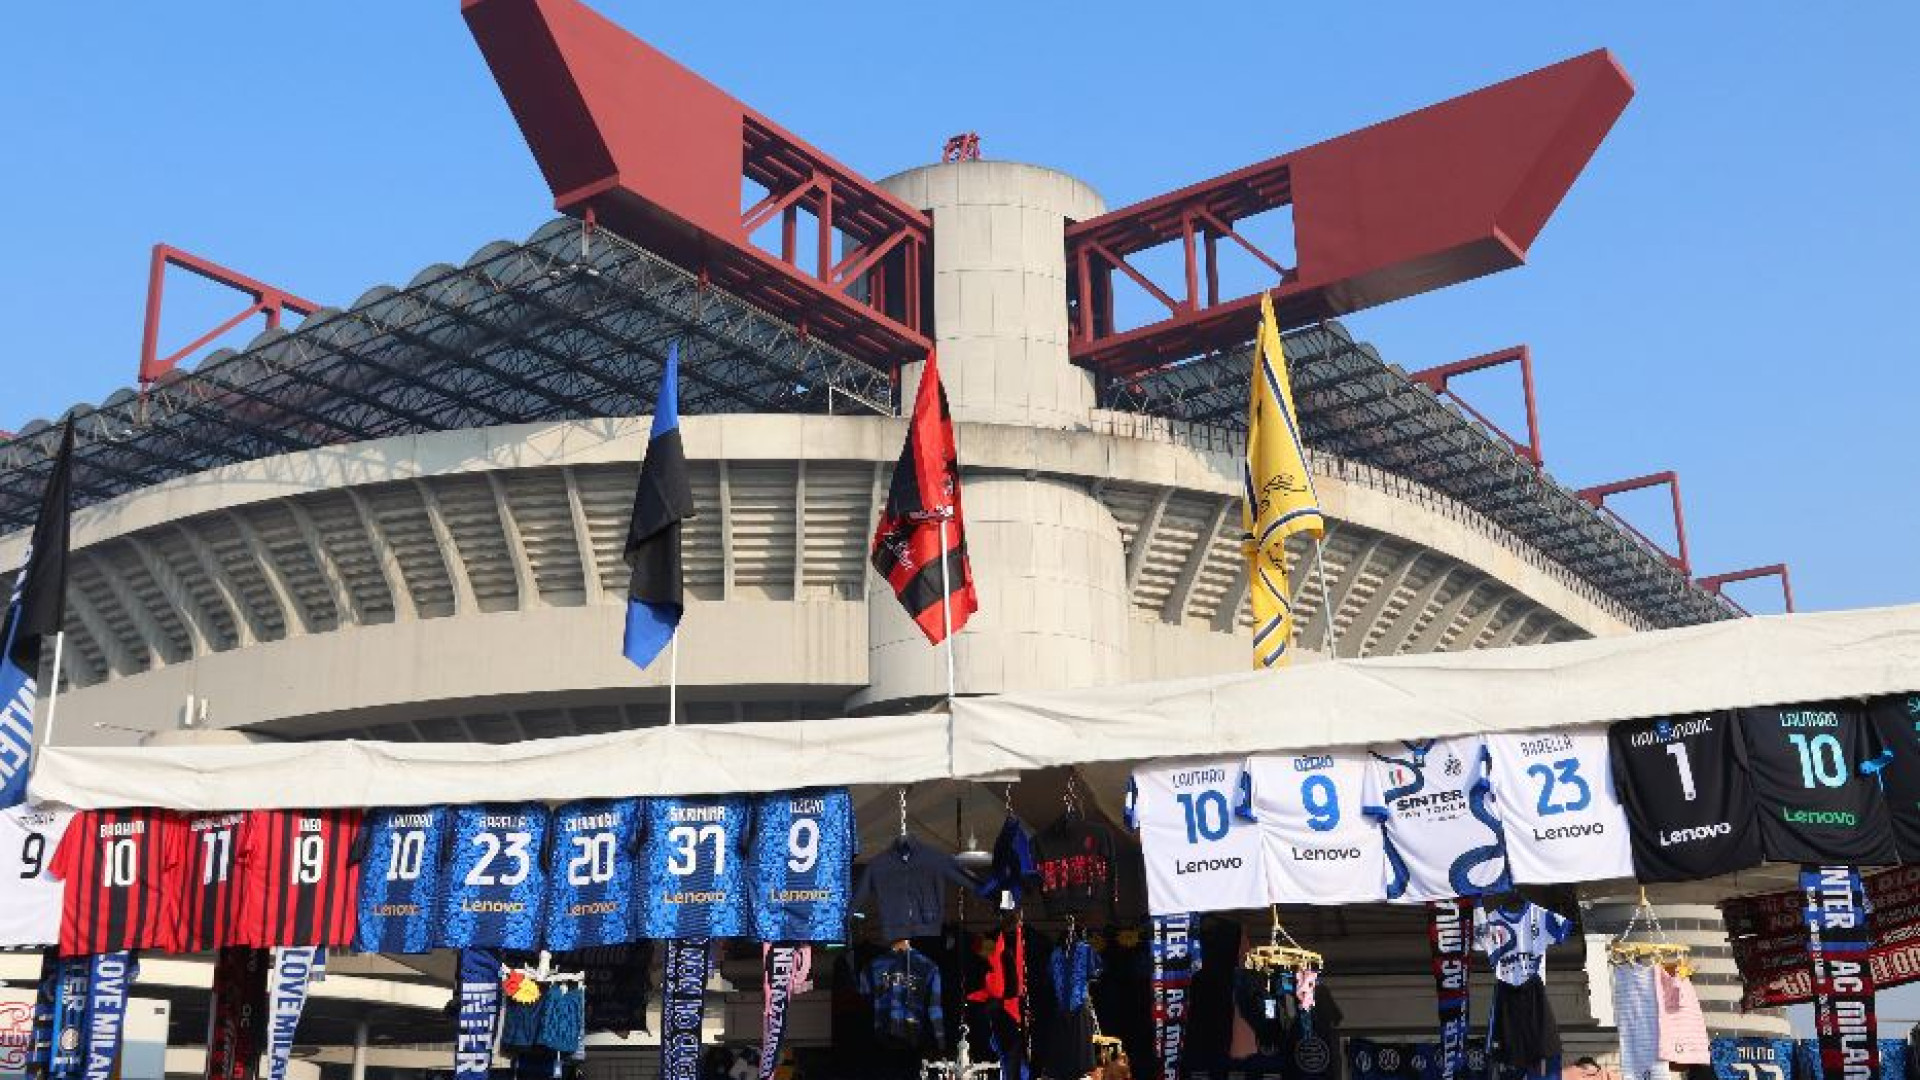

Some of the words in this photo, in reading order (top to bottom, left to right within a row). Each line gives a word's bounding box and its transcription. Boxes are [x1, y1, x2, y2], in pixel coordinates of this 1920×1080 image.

[1666, 742, 1697, 801] 1
[1789, 733, 1848, 789] 10
[1301, 775, 1340, 832] 9
[1527, 757, 1592, 817] 23
[1177, 789, 1230, 844] 10
[1534, 823, 1604, 842] Lenovo
[1660, 822, 1732, 847] Lenovo
[1784, 807, 1855, 826] Lenovo
[20, 833, 45, 879] 9
[103, 839, 136, 887] 10
[203, 831, 231, 885] 11
[291, 835, 324, 885] 19
[386, 831, 426, 881] 10
[465, 833, 532, 885] 23
[567, 833, 616, 885] 20
[788, 819, 820, 873] 9
[1176, 858, 1243, 875] Lenovo
[1292, 847, 1361, 861] Lenovo
[462, 896, 525, 912] Lenovo
[565, 902, 618, 917] Lenovo
[664, 889, 727, 904] Lenovo
[771, 888, 833, 902] Lenovo
[1820, 865, 1855, 930] INTER
[278, 949, 312, 1010] LOVE
[1441, 960, 1462, 989] AC
[1830, 960, 1863, 993] AC
[457, 982, 497, 1075] INTER
[1166, 989, 1184, 1019] AC
